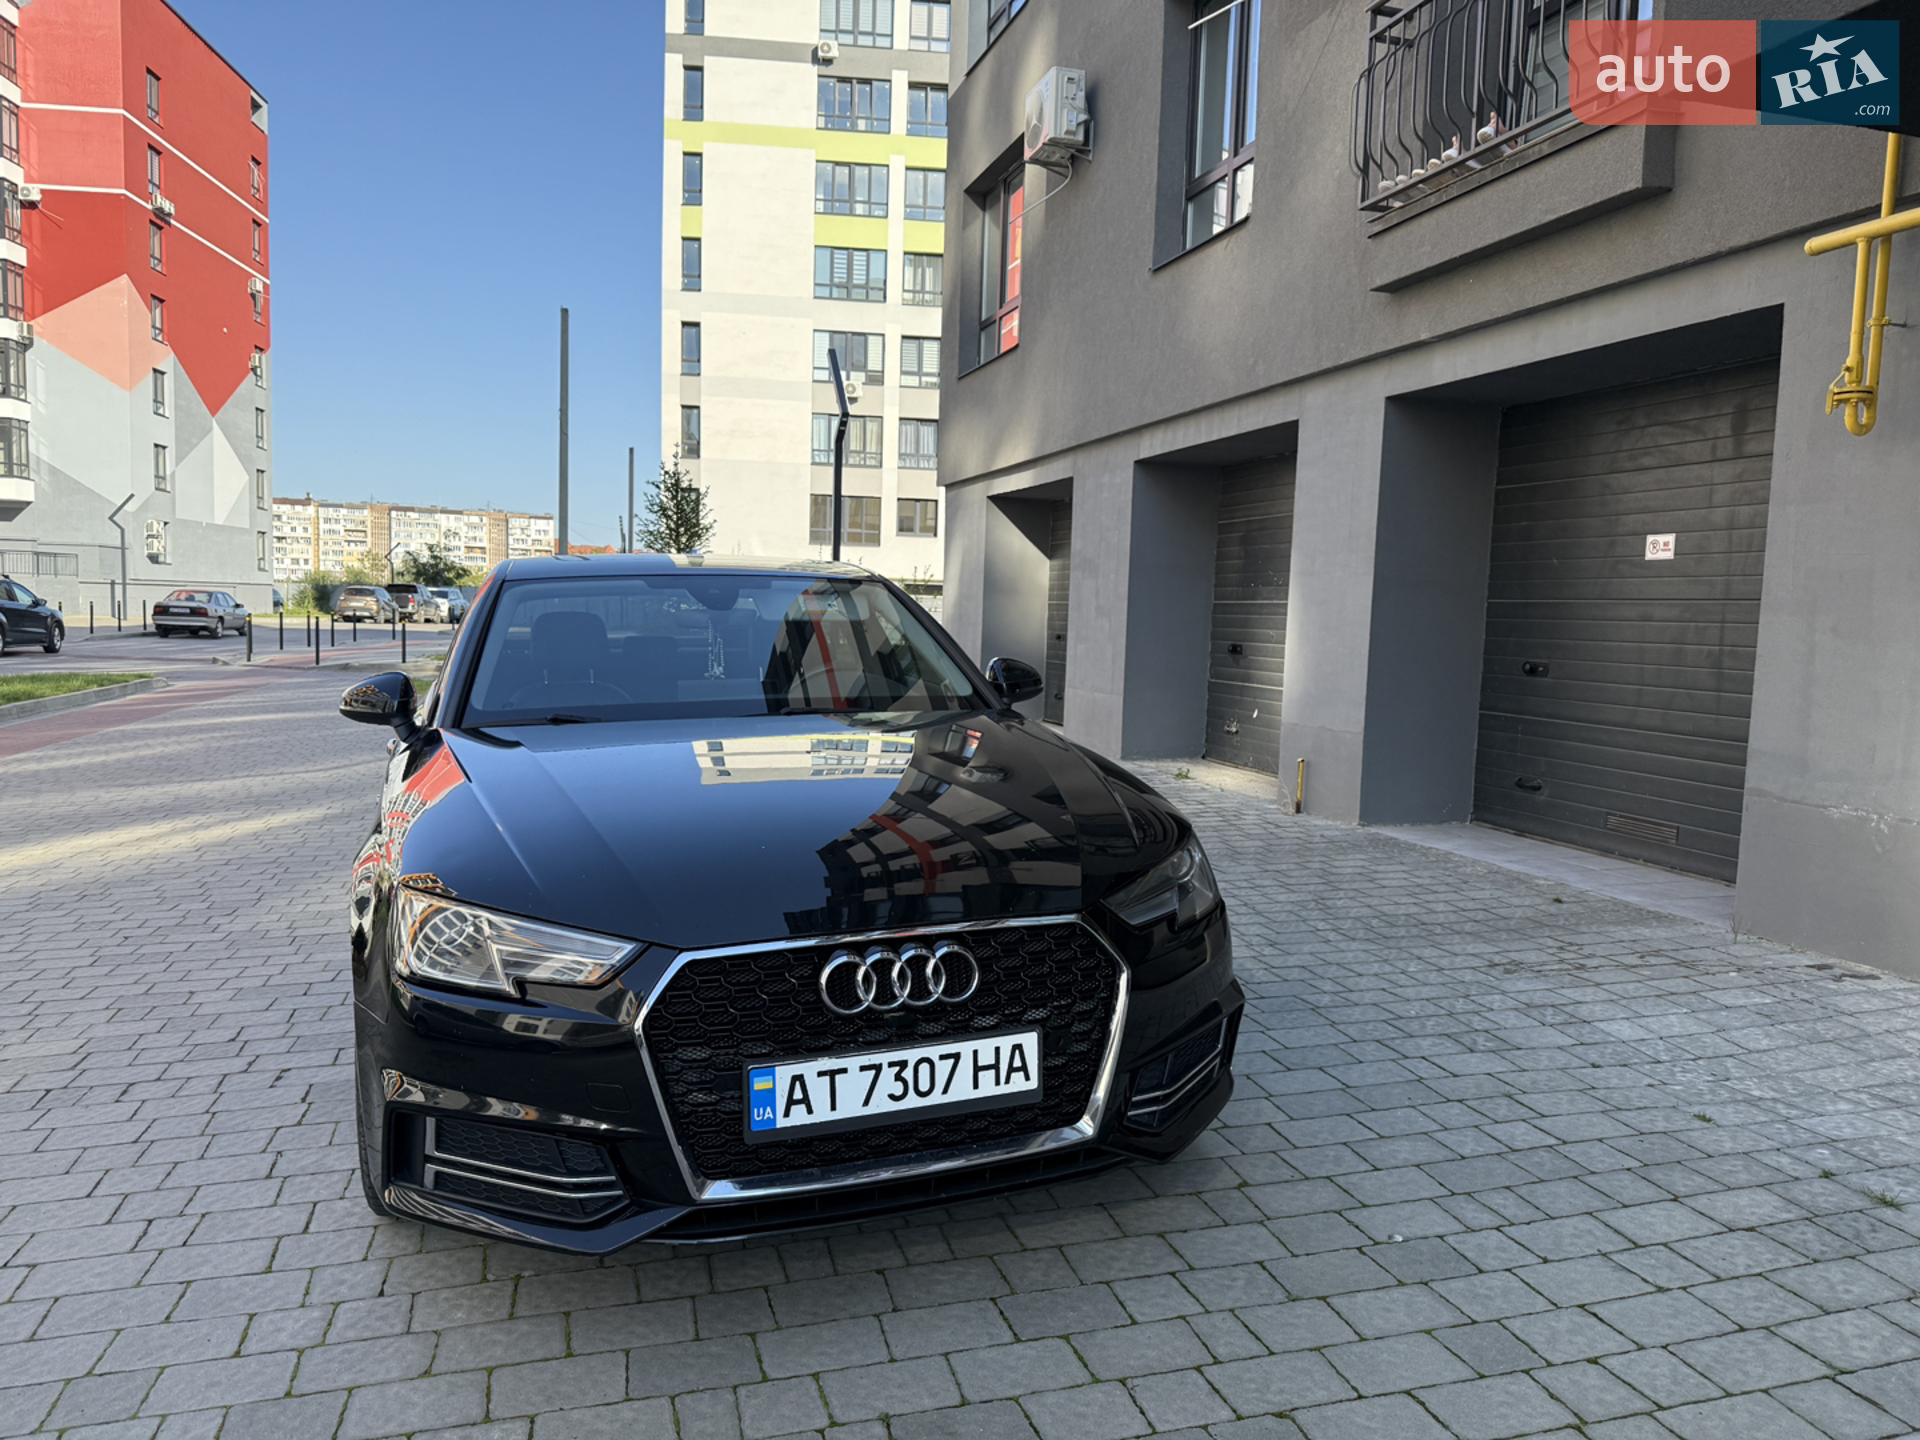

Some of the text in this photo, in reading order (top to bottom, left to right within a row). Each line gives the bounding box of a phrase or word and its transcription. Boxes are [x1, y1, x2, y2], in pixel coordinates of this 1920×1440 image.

[783, 1043, 1031, 1118] AT 7307 HA
[754, 1106, 774, 1120] UA
